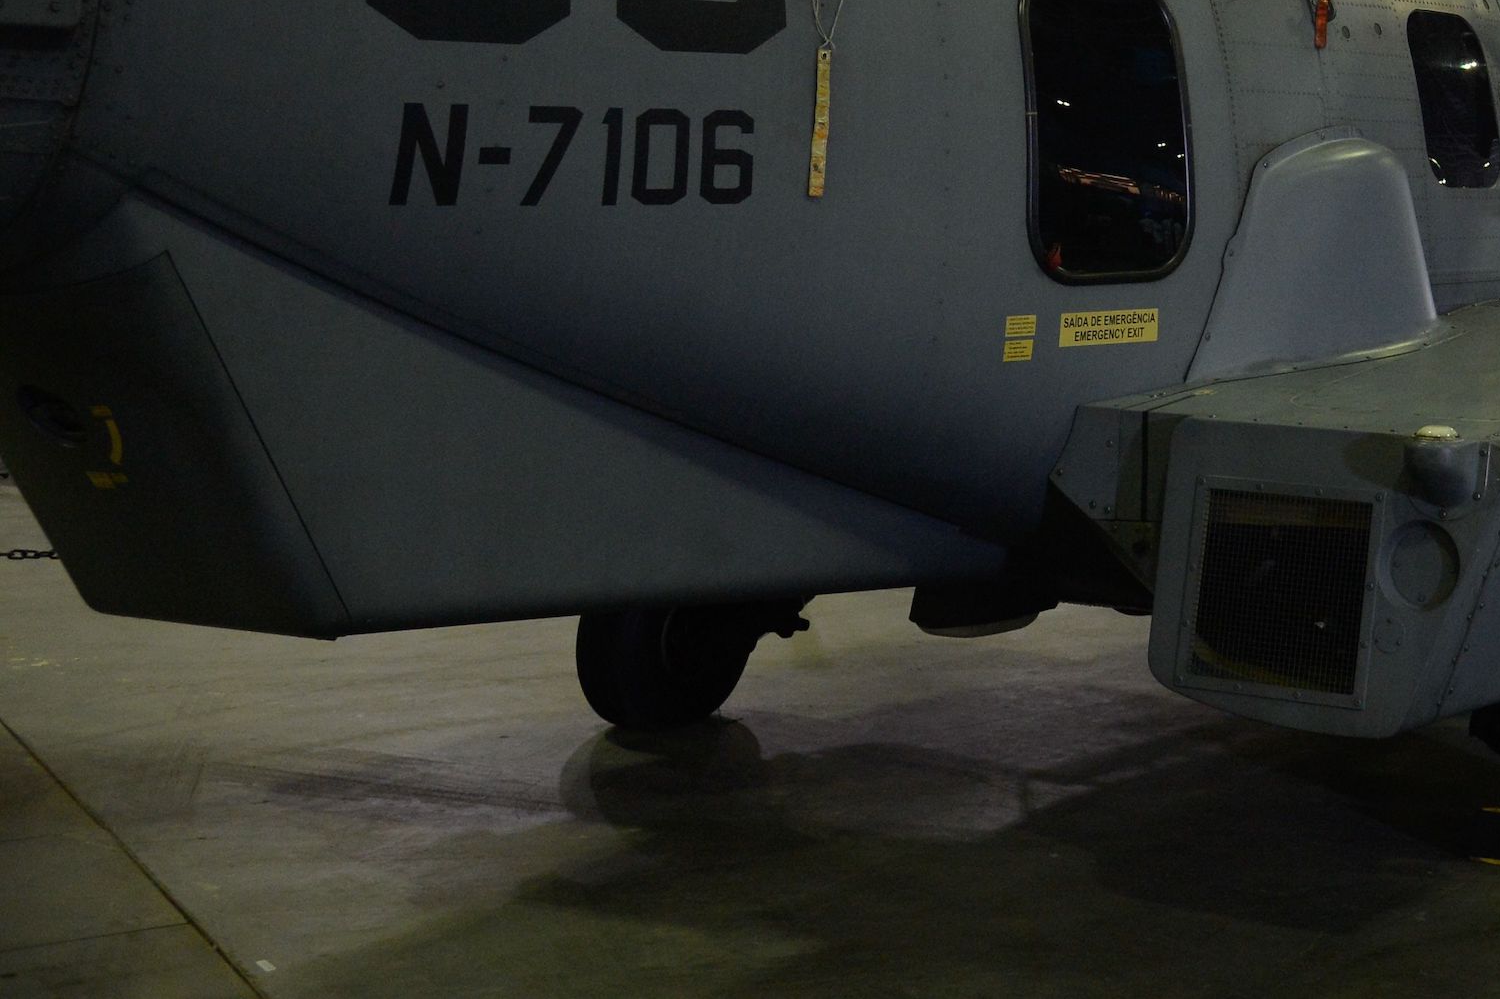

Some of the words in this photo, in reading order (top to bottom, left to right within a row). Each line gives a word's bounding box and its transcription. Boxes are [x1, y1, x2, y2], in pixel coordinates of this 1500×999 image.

[389, 102, 754, 206] N-7106
[1063, 314, 1089, 328] SAÍDA
[1090, 315, 1102, 327] DE
[1103, 311, 1156, 326] EMERGÊNCIA
[1074, 328, 1126, 342] EMERGENCY
[1127, 327, 1145, 339] EXIT
